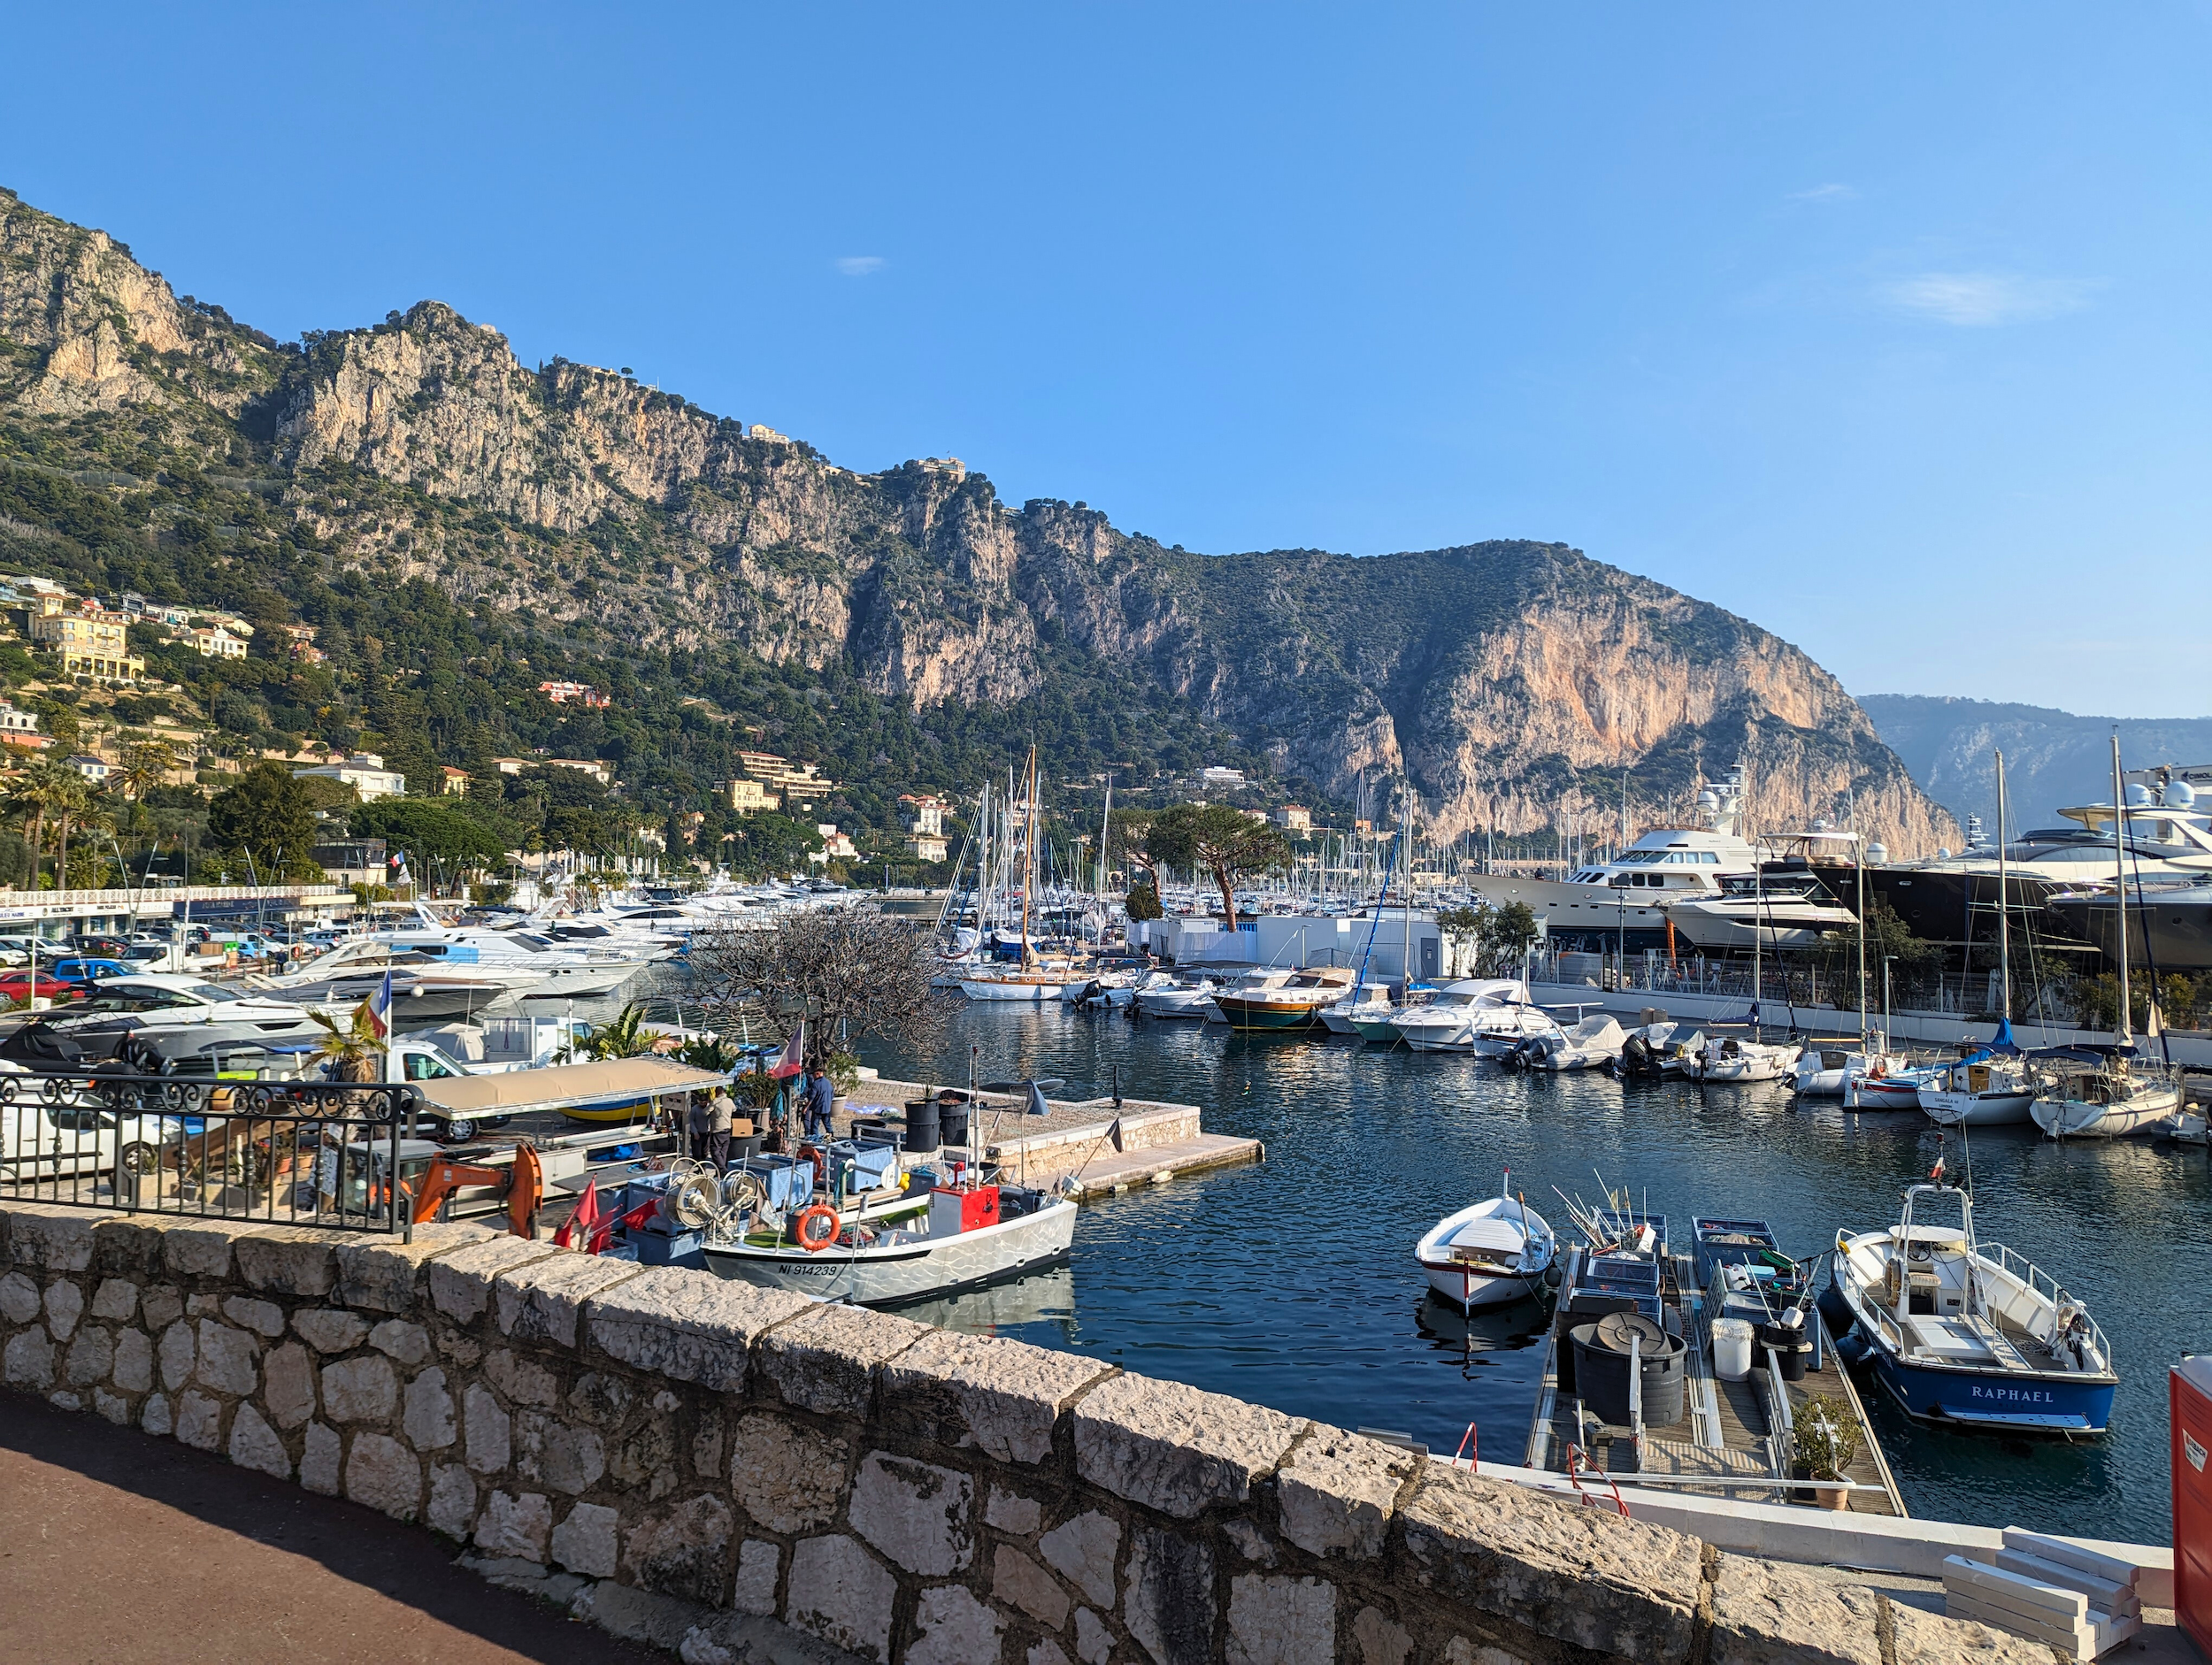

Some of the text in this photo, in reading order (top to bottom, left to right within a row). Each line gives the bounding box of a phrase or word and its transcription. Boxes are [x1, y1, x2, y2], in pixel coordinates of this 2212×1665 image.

[779, 1264, 837, 1276] NI 914239
[1971, 1385, 2054, 1403] RAPHAEL
